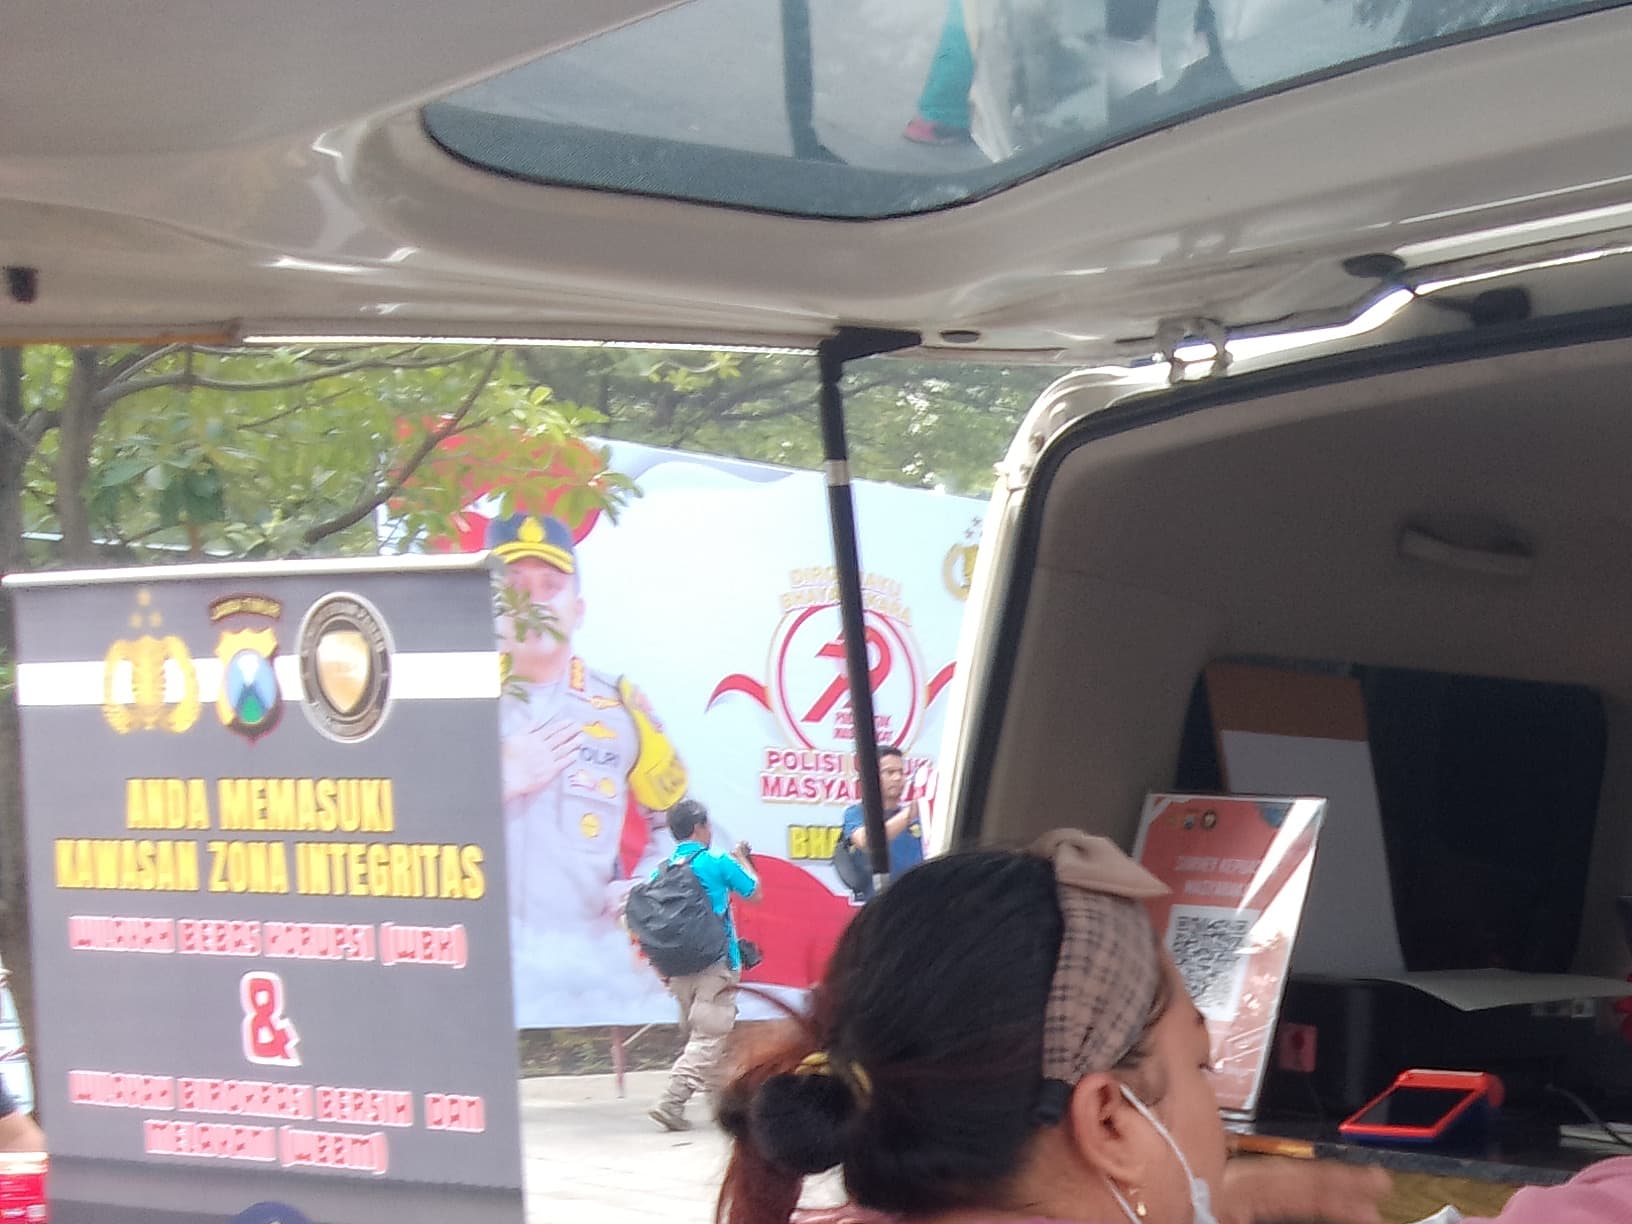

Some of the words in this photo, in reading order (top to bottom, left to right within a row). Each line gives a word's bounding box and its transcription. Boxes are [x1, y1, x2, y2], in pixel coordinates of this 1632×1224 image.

[766, 750, 843, 772] POLISI
[126, 777, 210, 830] ANDA
[216, 777, 395, 833] MEMASUKI
[54, 838, 199, 892] KAWASAN
[207, 841, 288, 895] ZONA
[296, 842, 487, 901] INTEGRITAS
[241, 971, 301, 1066] &
